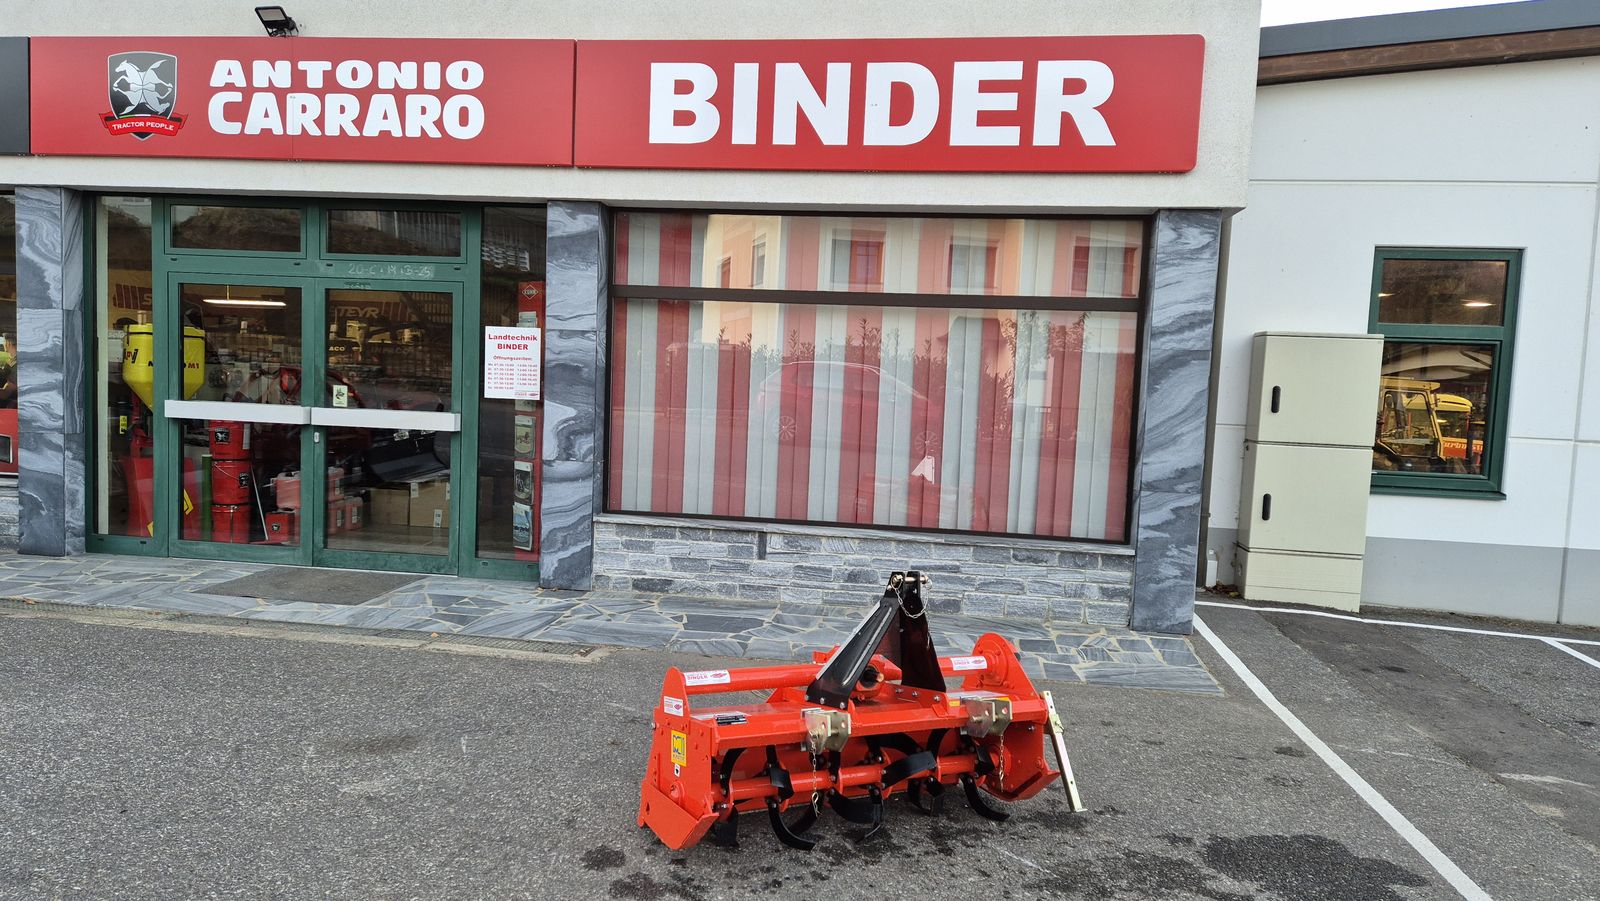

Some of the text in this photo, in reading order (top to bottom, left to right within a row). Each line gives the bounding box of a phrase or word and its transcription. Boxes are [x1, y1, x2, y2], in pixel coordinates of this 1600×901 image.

[209, 59, 485, 91] ANTONIO
[649, 59, 1116, 147] BINDER
[112, 121, 174, 131] TRACTOR PEOPLE
[207, 91, 485, 140] CARRARO
[488, 333, 538, 341] Landtechnik
[497, 343, 529, 351] BINDER
